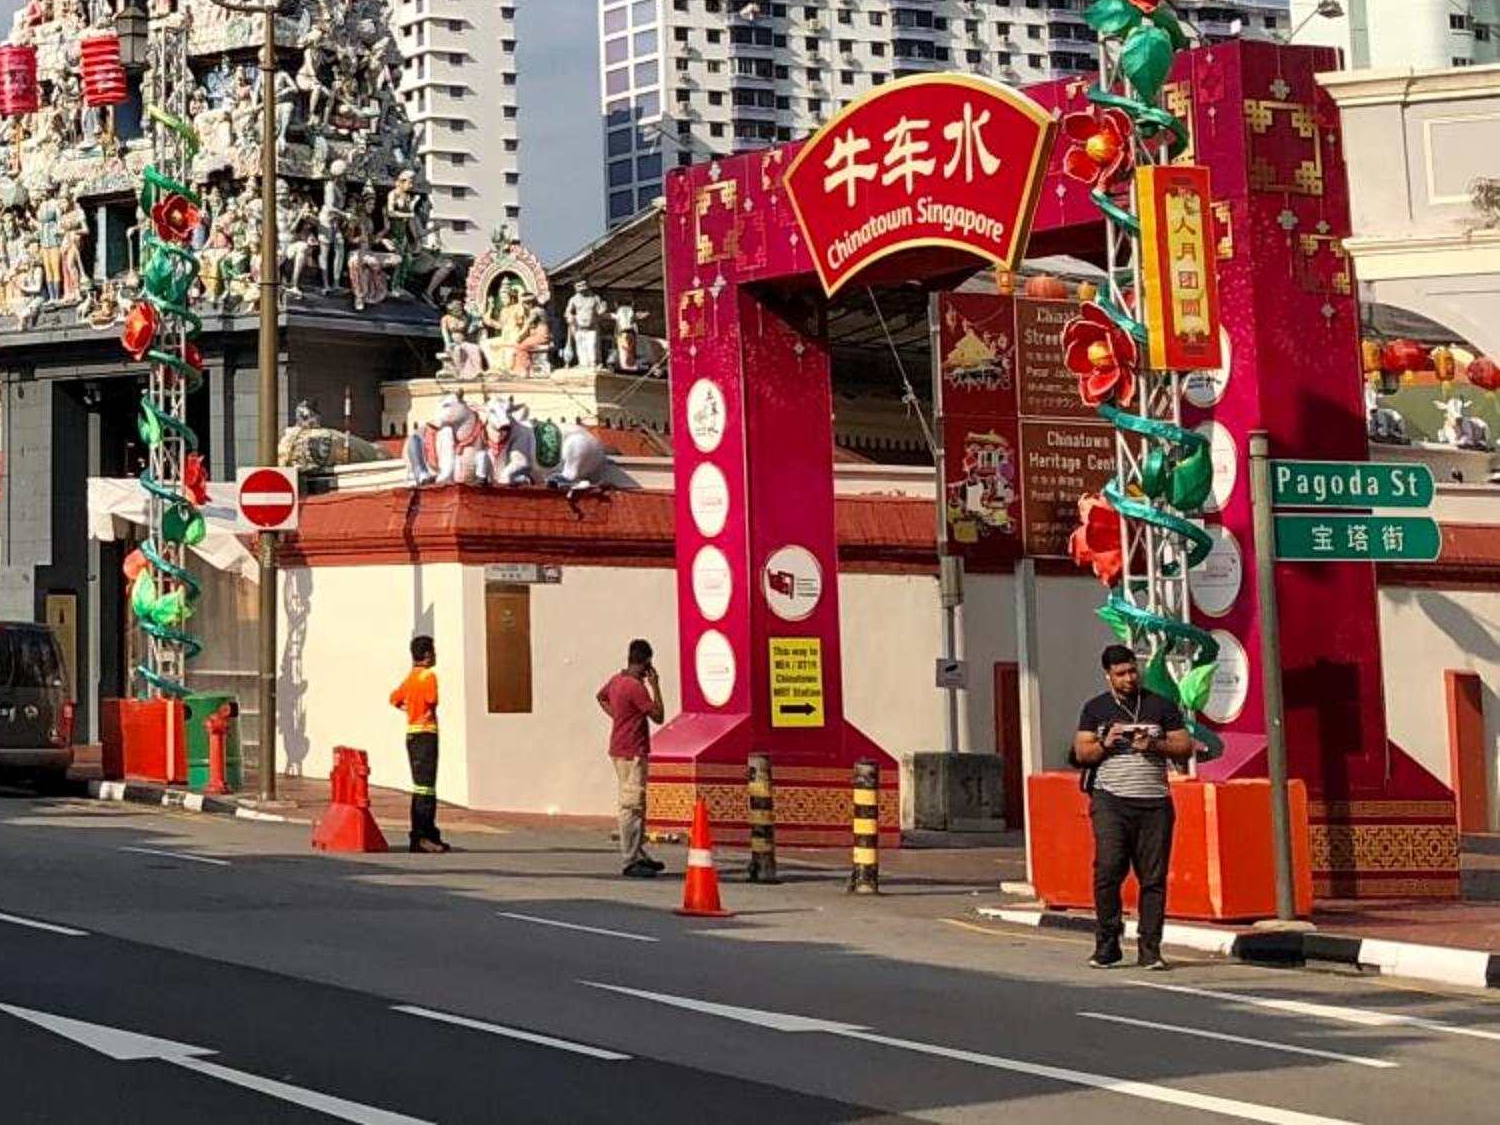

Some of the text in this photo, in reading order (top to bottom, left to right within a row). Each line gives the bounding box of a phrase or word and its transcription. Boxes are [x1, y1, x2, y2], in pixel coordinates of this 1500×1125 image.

[823, 101, 1002, 208] 牛车水
[826, 196, 1005, 270] Chinatown Singapore
[1024, 329, 1060, 345] Stree
[1047, 430, 1110, 449] Chinatown
[1028, 452, 1082, 473] Heritage
[1276, 466, 1419, 502] Pagoda St
[1311, 524, 1404, 553] 宝塔街
